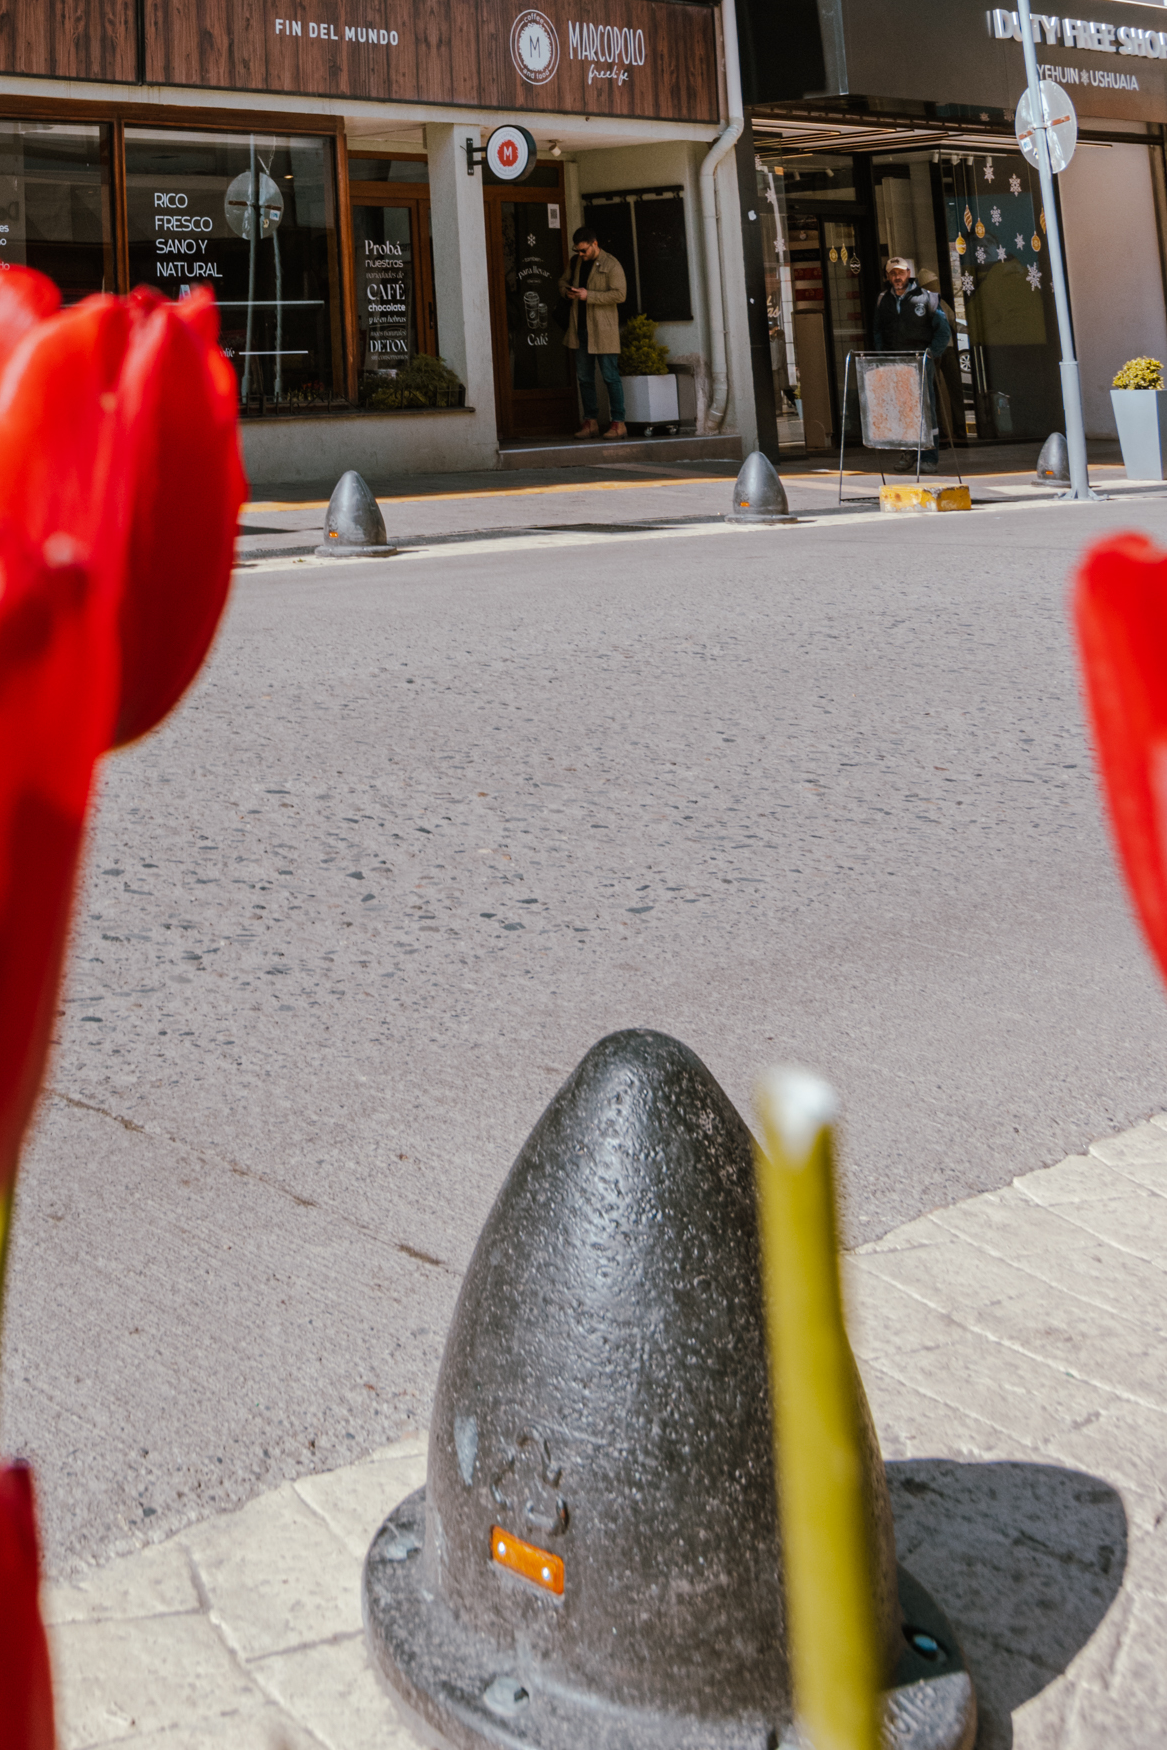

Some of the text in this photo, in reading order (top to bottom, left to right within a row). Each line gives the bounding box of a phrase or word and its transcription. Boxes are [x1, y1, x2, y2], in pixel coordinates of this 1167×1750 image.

[523, 13, 545, 25] coffee
[275, 18, 399, 46] FIN DEL MUNDO
[1062, 18, 1117, 53] FREE
[529, 35, 541, 59] M
[568, 20, 645, 66] MARCOPOLO
[522, 68, 550, 80] and food
[1089, 70, 1140, 91] USHUAIA
[503, 145, 513, 161] M
[154, 193, 188, 208] RICO
[154, 215, 213, 231] FRESCO
[155, 238, 208, 254] SANO Y
[364, 240, 402, 255] Probá
[156, 262, 223, 277] NATURAL
[518, 267, 533, 281] para
[367, 280, 406, 300] CAFÉ
[368, 302, 406, 312] chocolate
[370, 339, 408, 353] DETOX
[527, 333, 549, 346] Café
